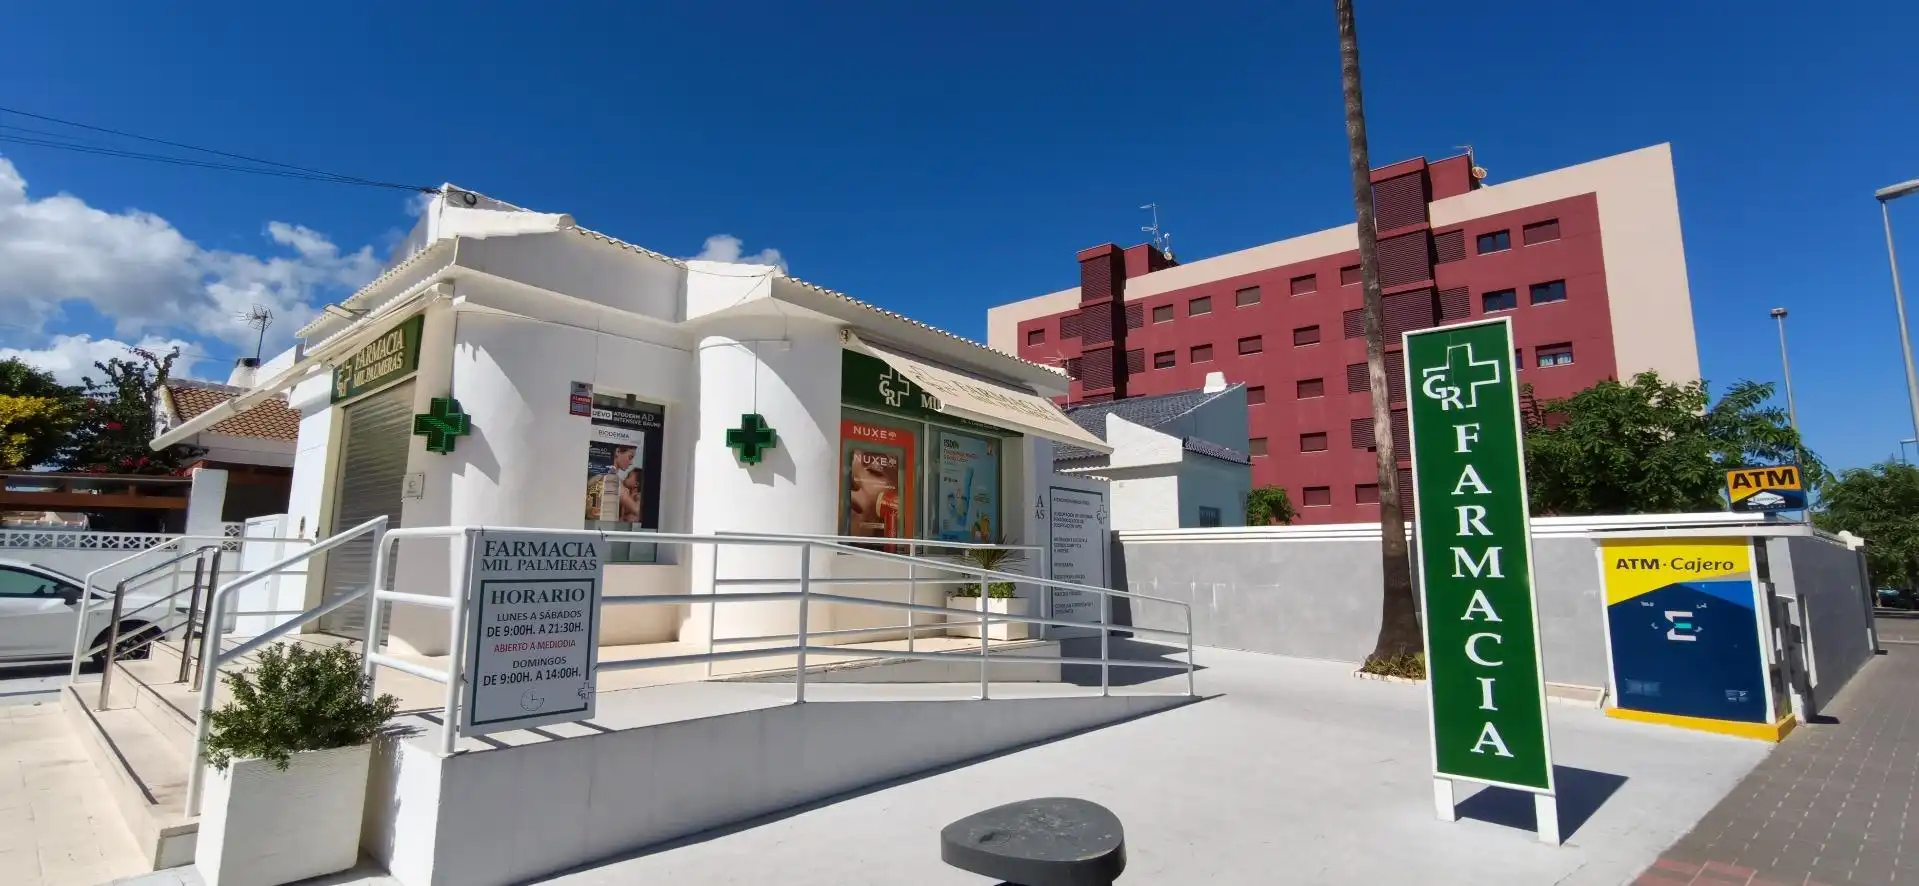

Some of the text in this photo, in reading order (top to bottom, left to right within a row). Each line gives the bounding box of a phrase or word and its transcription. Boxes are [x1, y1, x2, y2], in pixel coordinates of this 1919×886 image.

[355, 328, 405, 371] FARMACIA
[366, 351, 404, 382] PALMERAS
[598, 429, 630, 439] BIODERMA
[853, 425, 888, 439] NUXE
[853, 453, 888, 467] NUXE
[1732, 469, 1795, 489] ATM
[483, 540, 597, 558] FARMACIA
[481, 559, 597, 572] MIL PALMERAS
[1616, 557, 1734, 571] ATM Cajero
[491, 588, 585, 605] HORARIO
[1450, 422, 1515, 758] FARMACIA
[497, 612, 528, 622] LUNES
[530, 613, 537, 621] A
[487, 622, 584, 638] DE 9:00H. A 21:30H.
[494, 643, 528, 654] ABIERTO
[530, 643, 536, 651] A
[512, 656, 567, 669] DOMINGOS
[483, 667, 581, 687] DE 9:00H. A 14:00H.
